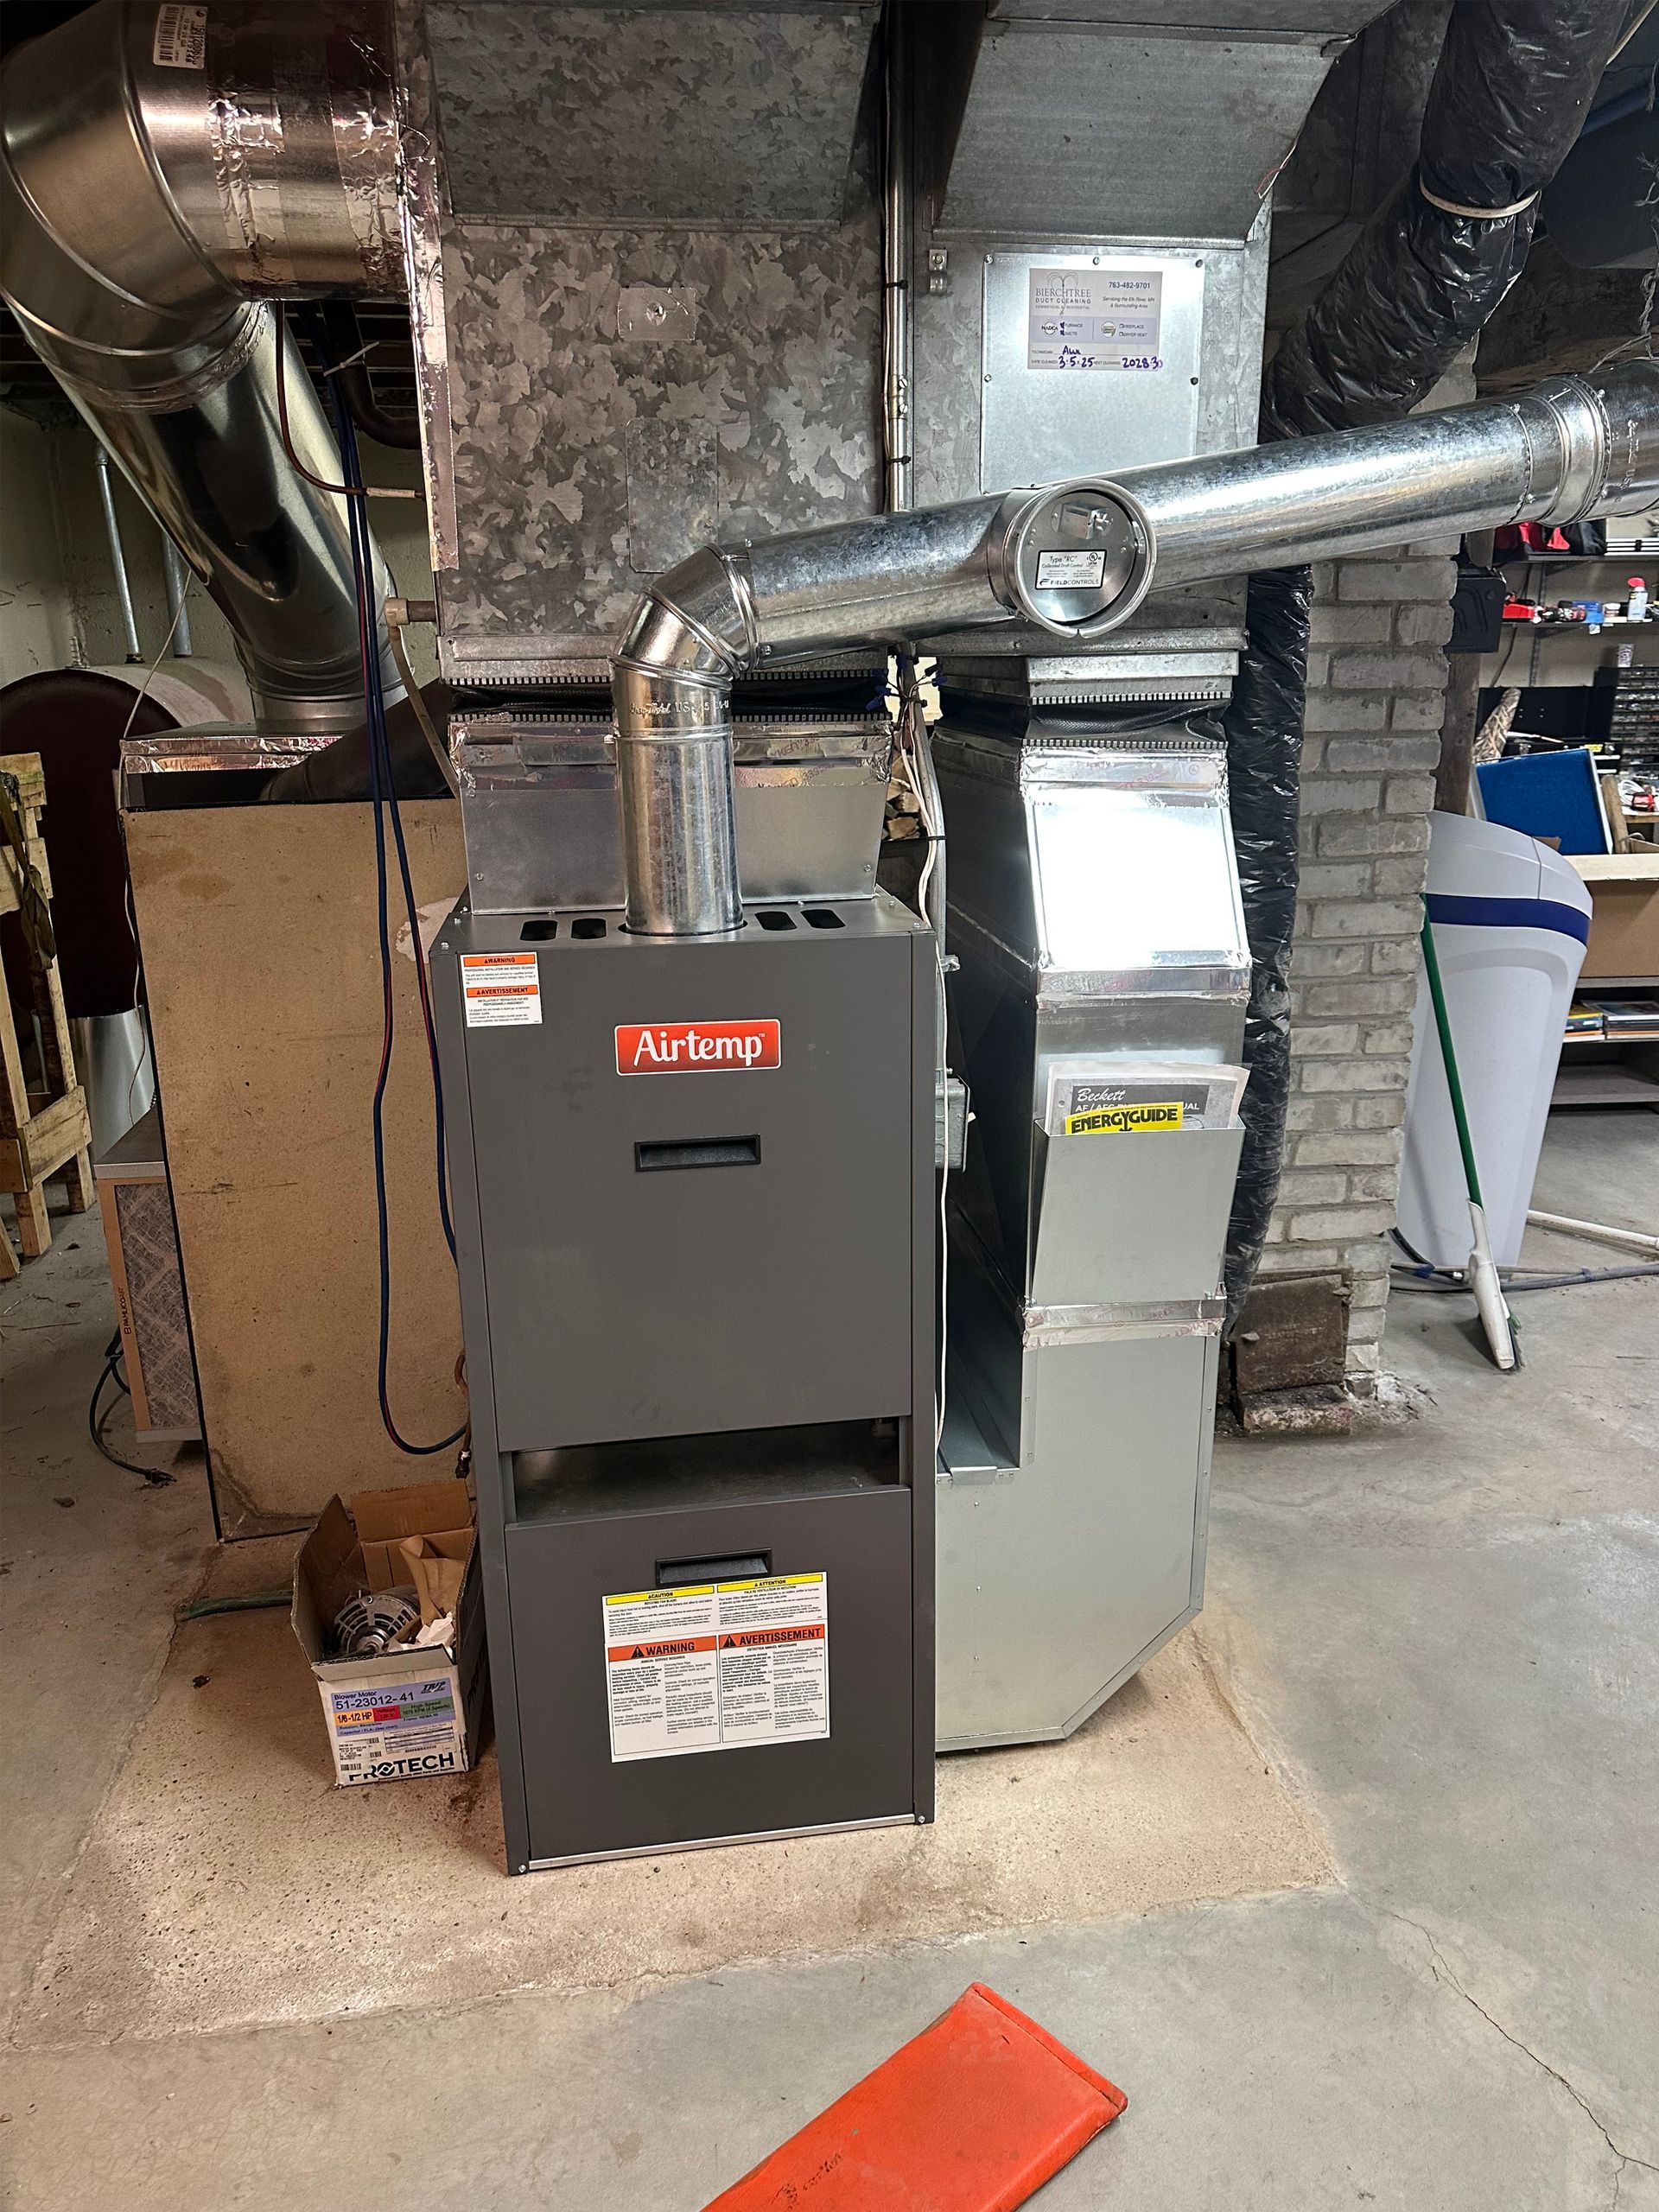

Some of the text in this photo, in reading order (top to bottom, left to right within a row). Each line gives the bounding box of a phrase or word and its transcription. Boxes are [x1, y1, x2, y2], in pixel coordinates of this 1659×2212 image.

[1036, 288, 1091, 297] BIERCHTREE
[634, 1030, 762, 1067] Airtemp
[1077, 1088, 1126, 1102] Beckett
[1071, 1109, 1178, 1134] ENERGYGUIDE
[740, 1627, 821, 1645] AVERTISSEMENT
[646, 1642, 694, 1656] WARNING
